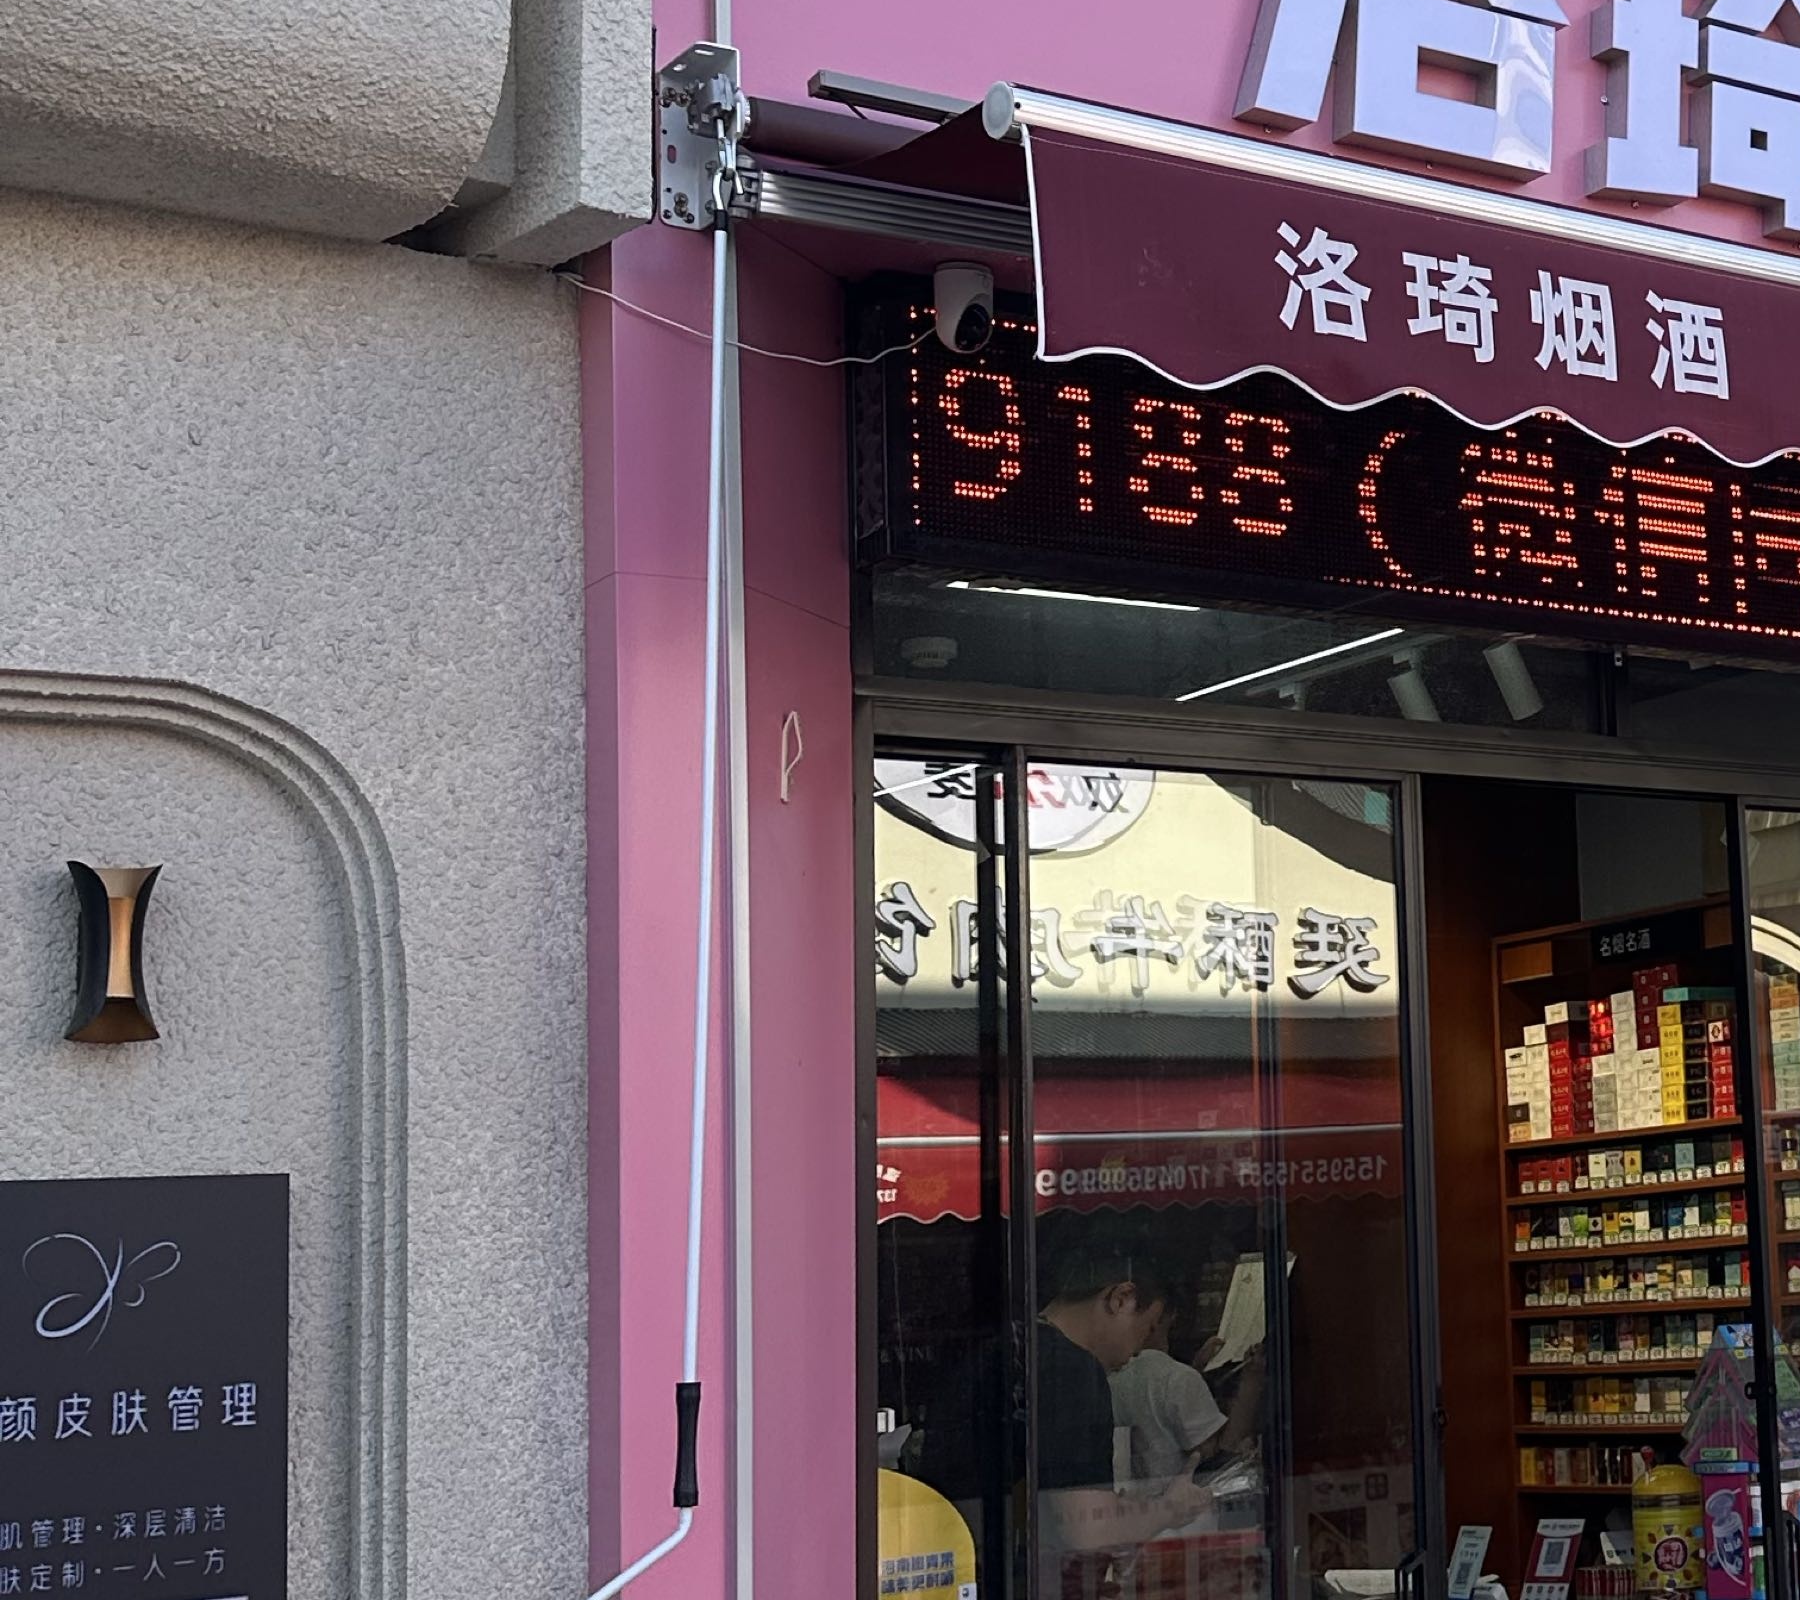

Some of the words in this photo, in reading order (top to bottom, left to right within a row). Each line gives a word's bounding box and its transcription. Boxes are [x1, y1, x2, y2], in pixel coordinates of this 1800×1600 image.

[1274, 220, 1731, 401] 洛琦烟酒
[0, 1382, 257, 1443] 颜皮肤管理
